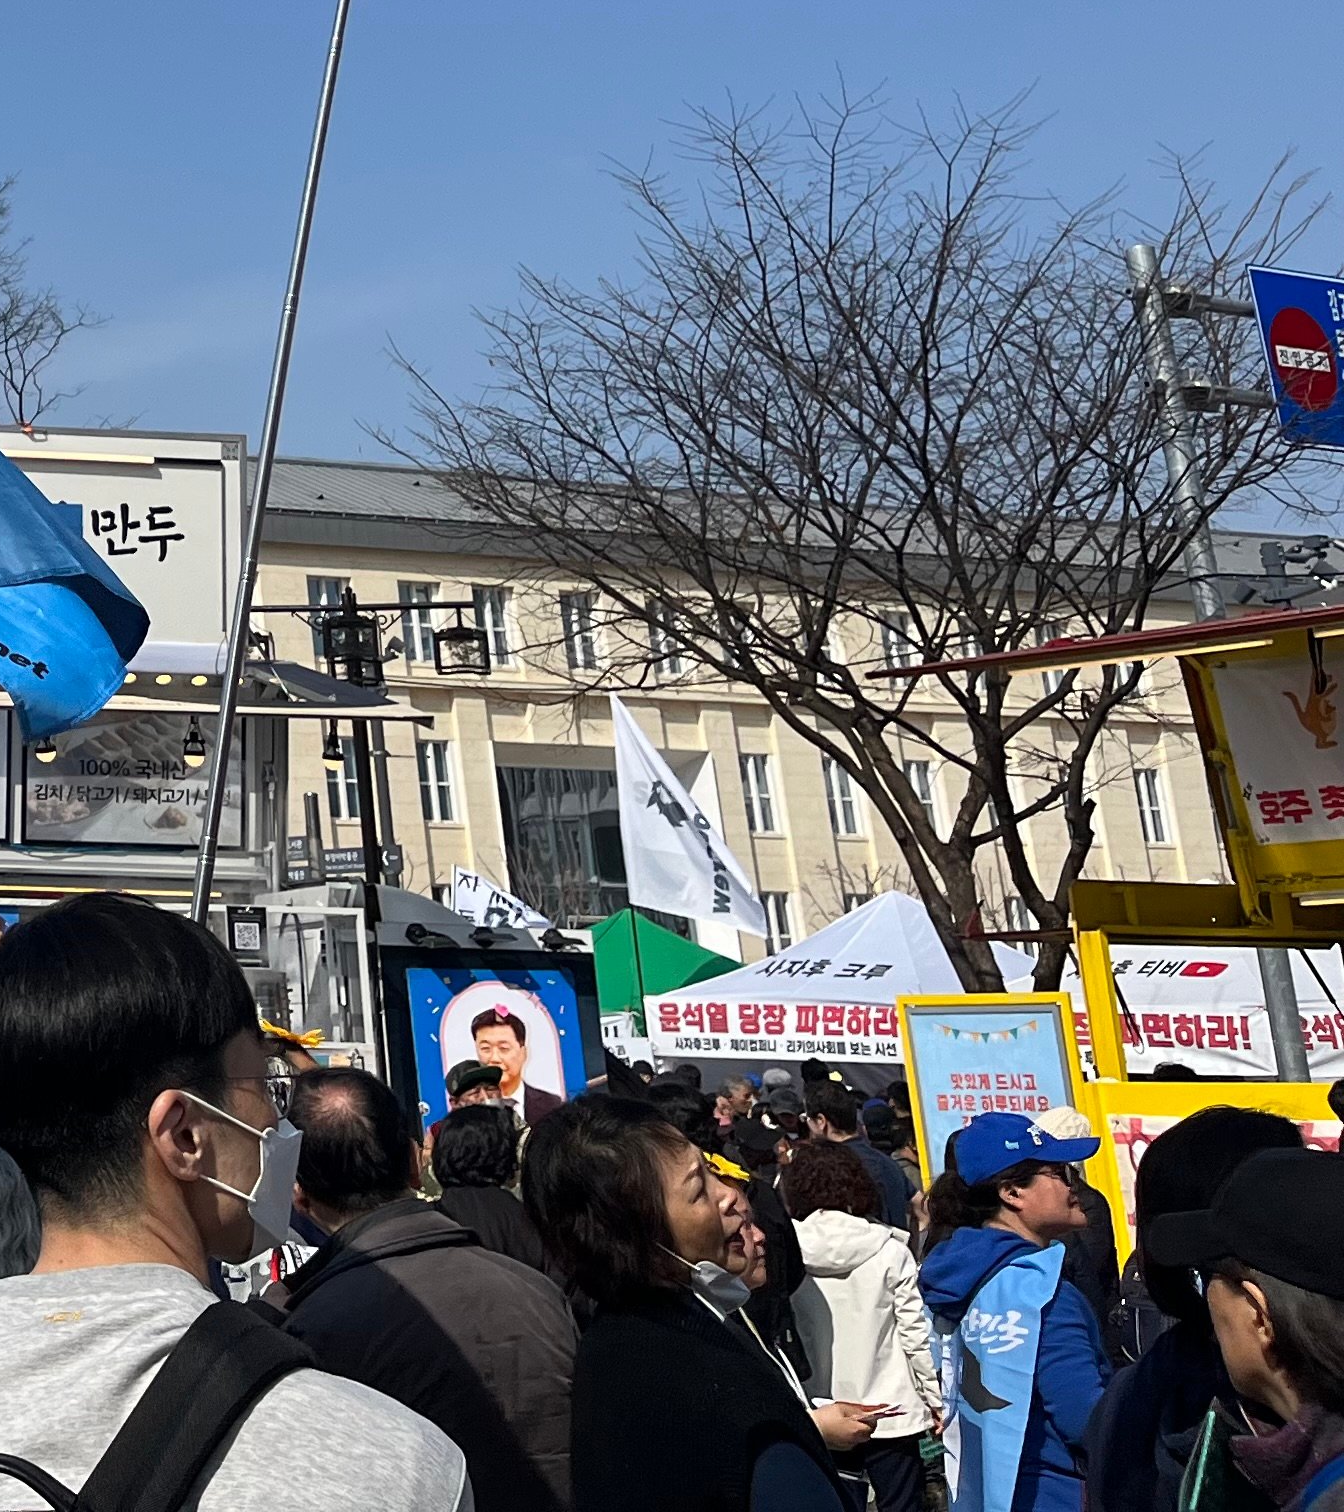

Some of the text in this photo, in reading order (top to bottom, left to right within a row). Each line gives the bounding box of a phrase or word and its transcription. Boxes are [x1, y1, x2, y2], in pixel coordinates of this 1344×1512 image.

[92, 502, 185, 562] 만두
[79, 760, 186, 780] 100% 국내산
[34, 784, 63, 802] 김치
[78, 785, 120, 803] 닭고기
[133, 788, 189, 805] 돼지고기
[1256, 789, 1312, 824] 호주
[756, 959, 893, 980] 사자후 크루
[1137, 960, 1187, 977] 티비
[658, 1002, 899, 1038] 윤석열 당장 파면하라
[675, 1037, 721, 1051] 사자후크루
[849, 1041, 871, 1056] 보는
[875, 1042, 897, 1057] 시선
[950, 1073, 1038, 1091] 맛있게 드시고
[936, 1094, 977, 1112] 즐거운
